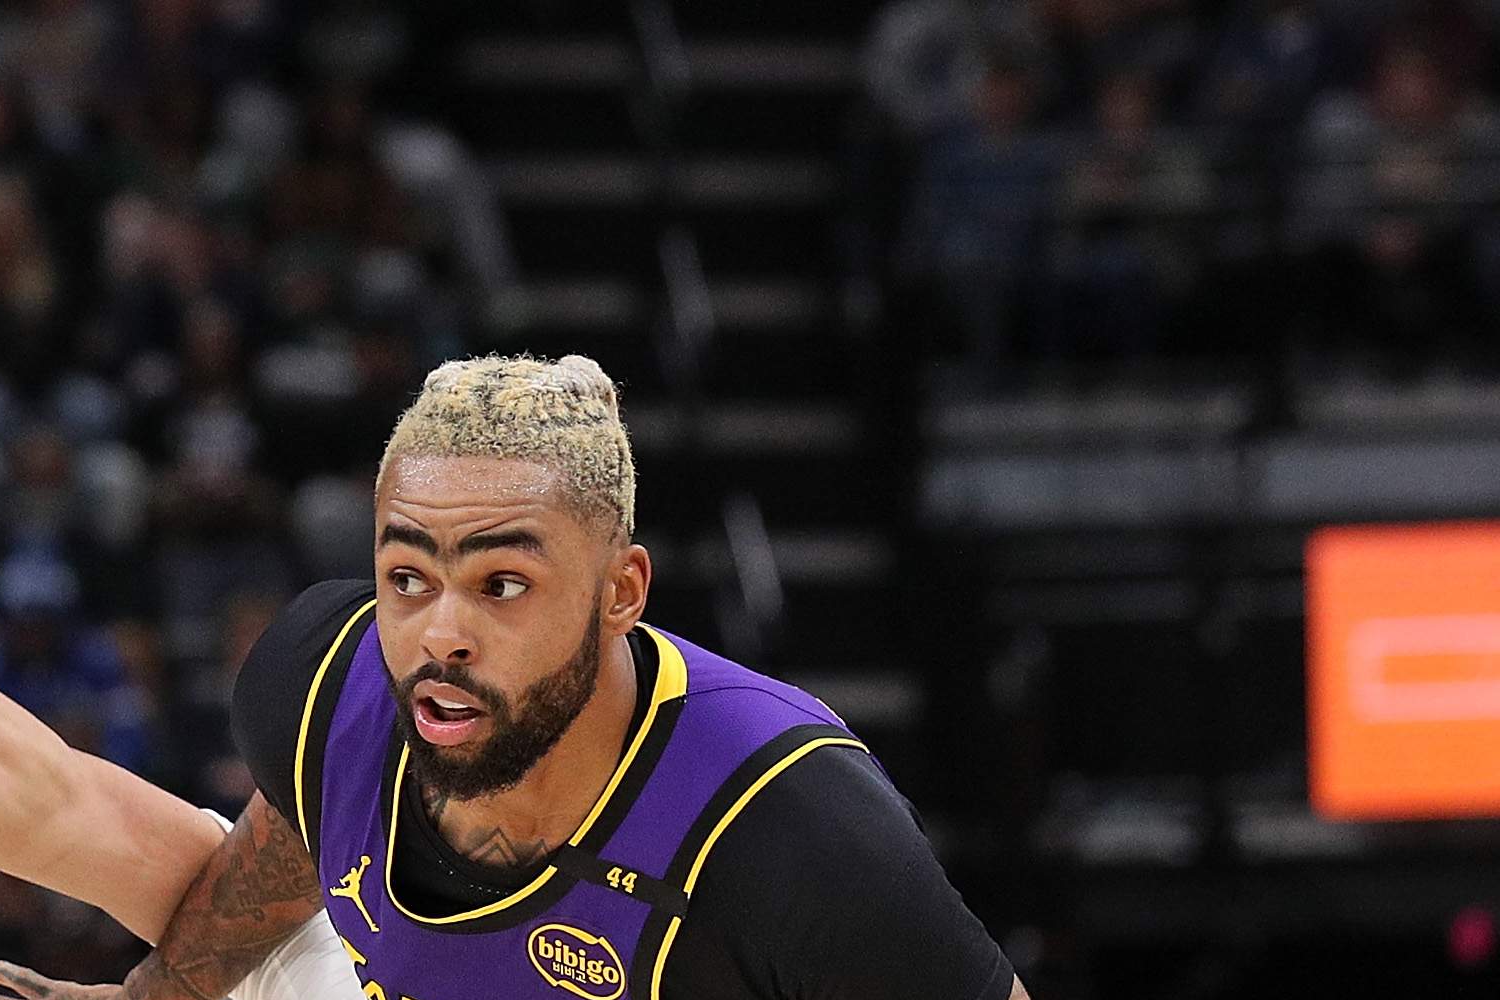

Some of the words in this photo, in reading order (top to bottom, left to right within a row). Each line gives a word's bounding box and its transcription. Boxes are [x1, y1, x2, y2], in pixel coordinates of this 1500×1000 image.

[606, 866, 638, 894] 44
[538, 935, 620, 985] bibigo
[552, 961, 587, 984] 비비고
